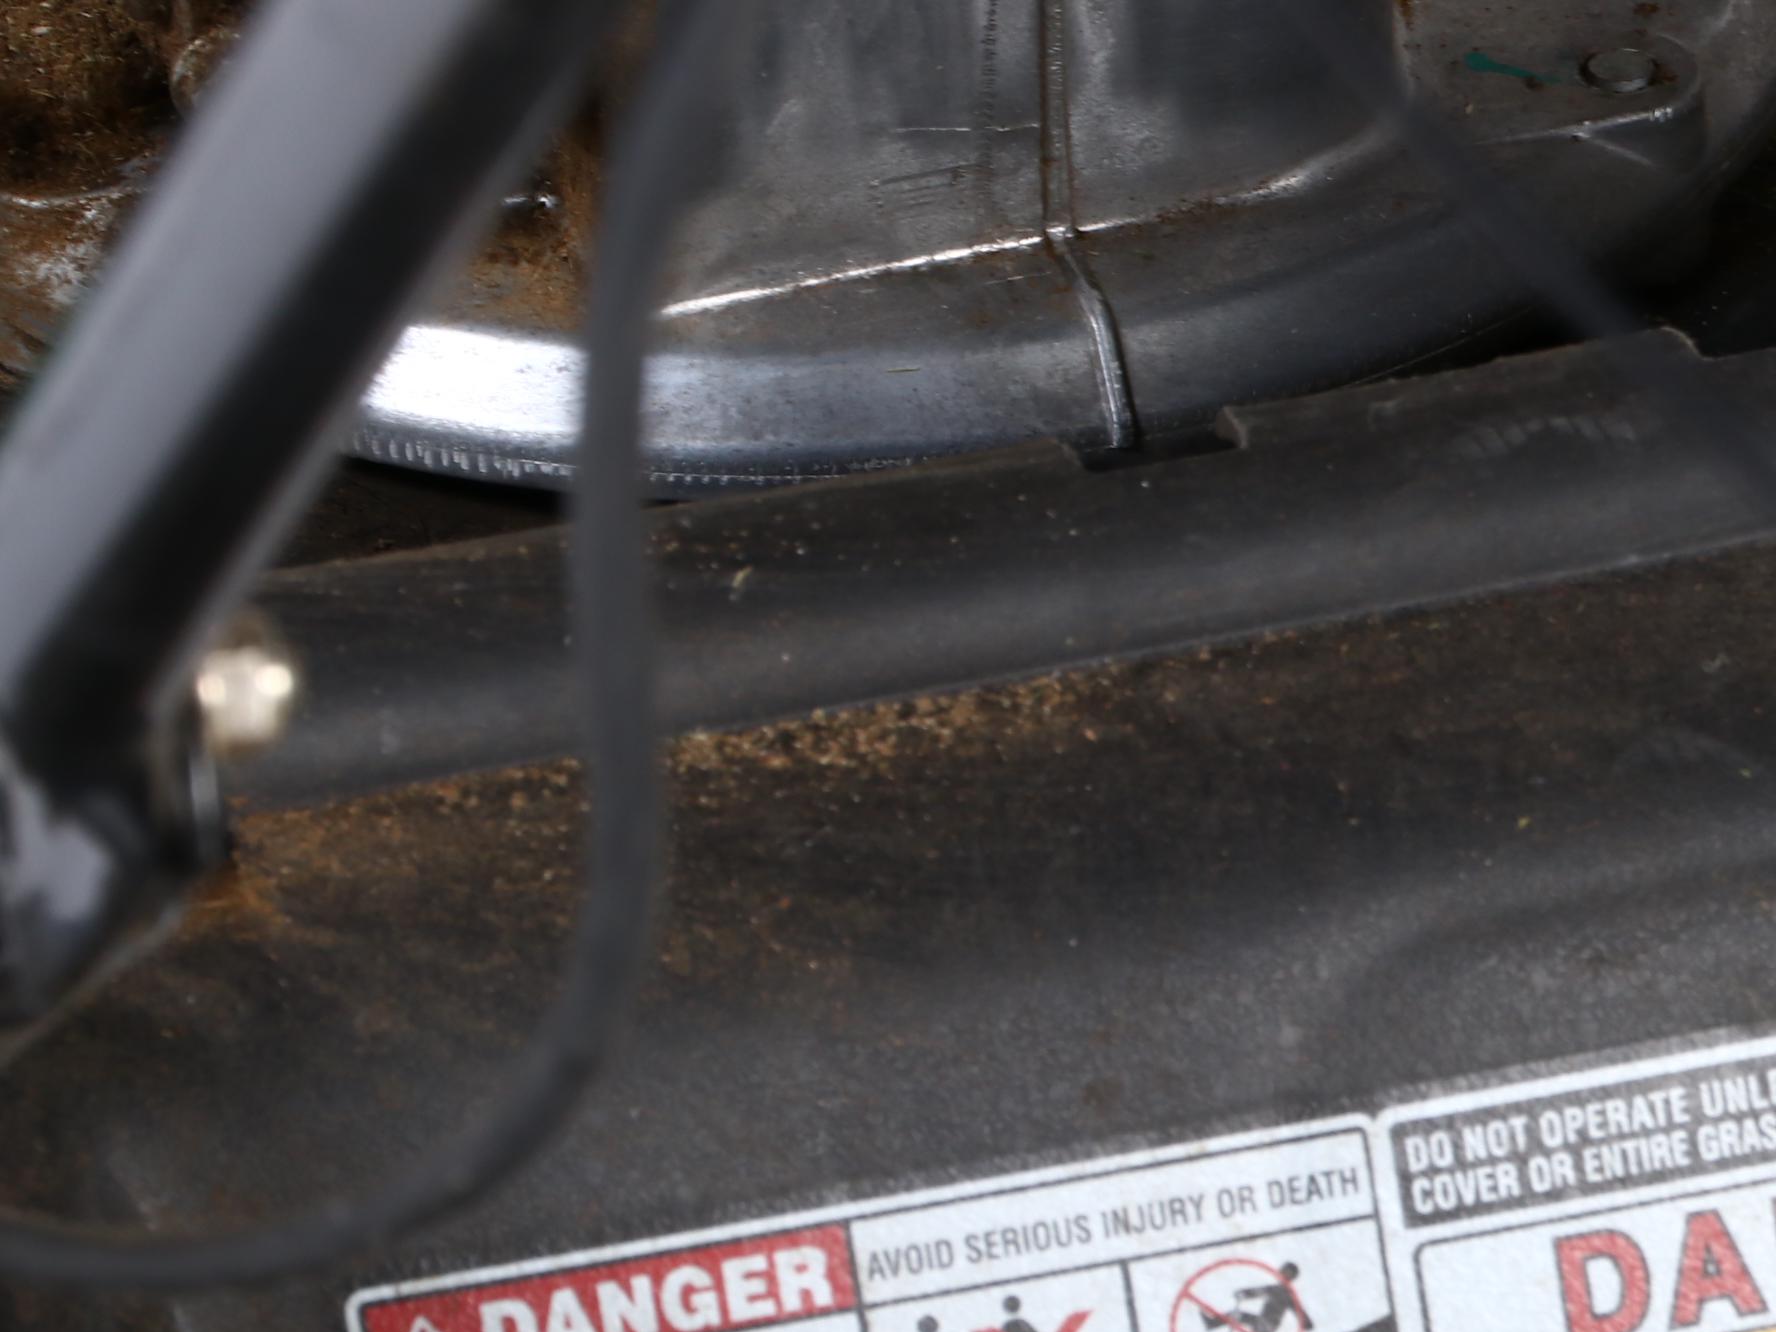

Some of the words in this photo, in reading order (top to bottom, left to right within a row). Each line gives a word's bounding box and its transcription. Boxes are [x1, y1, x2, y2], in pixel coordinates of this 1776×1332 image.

[1403, 1129, 1454, 1173] DO
[1461, 1114, 1532, 1163] NOT
[1537, 1086, 1691, 1149] OPERATE
[1410, 1161, 1521, 1215] COVER
[1527, 1151, 1575, 1194] OR
[1581, 1130, 1692, 1184] ENTIRE
[864, 1238, 956, 1283] AVOID
[963, 1213, 1093, 1265] SERIOUS
[1101, 1193, 1208, 1240] INJURY
[1216, 1184, 1258, 1220] OR
[1267, 1165, 1360, 1211] DEATH
